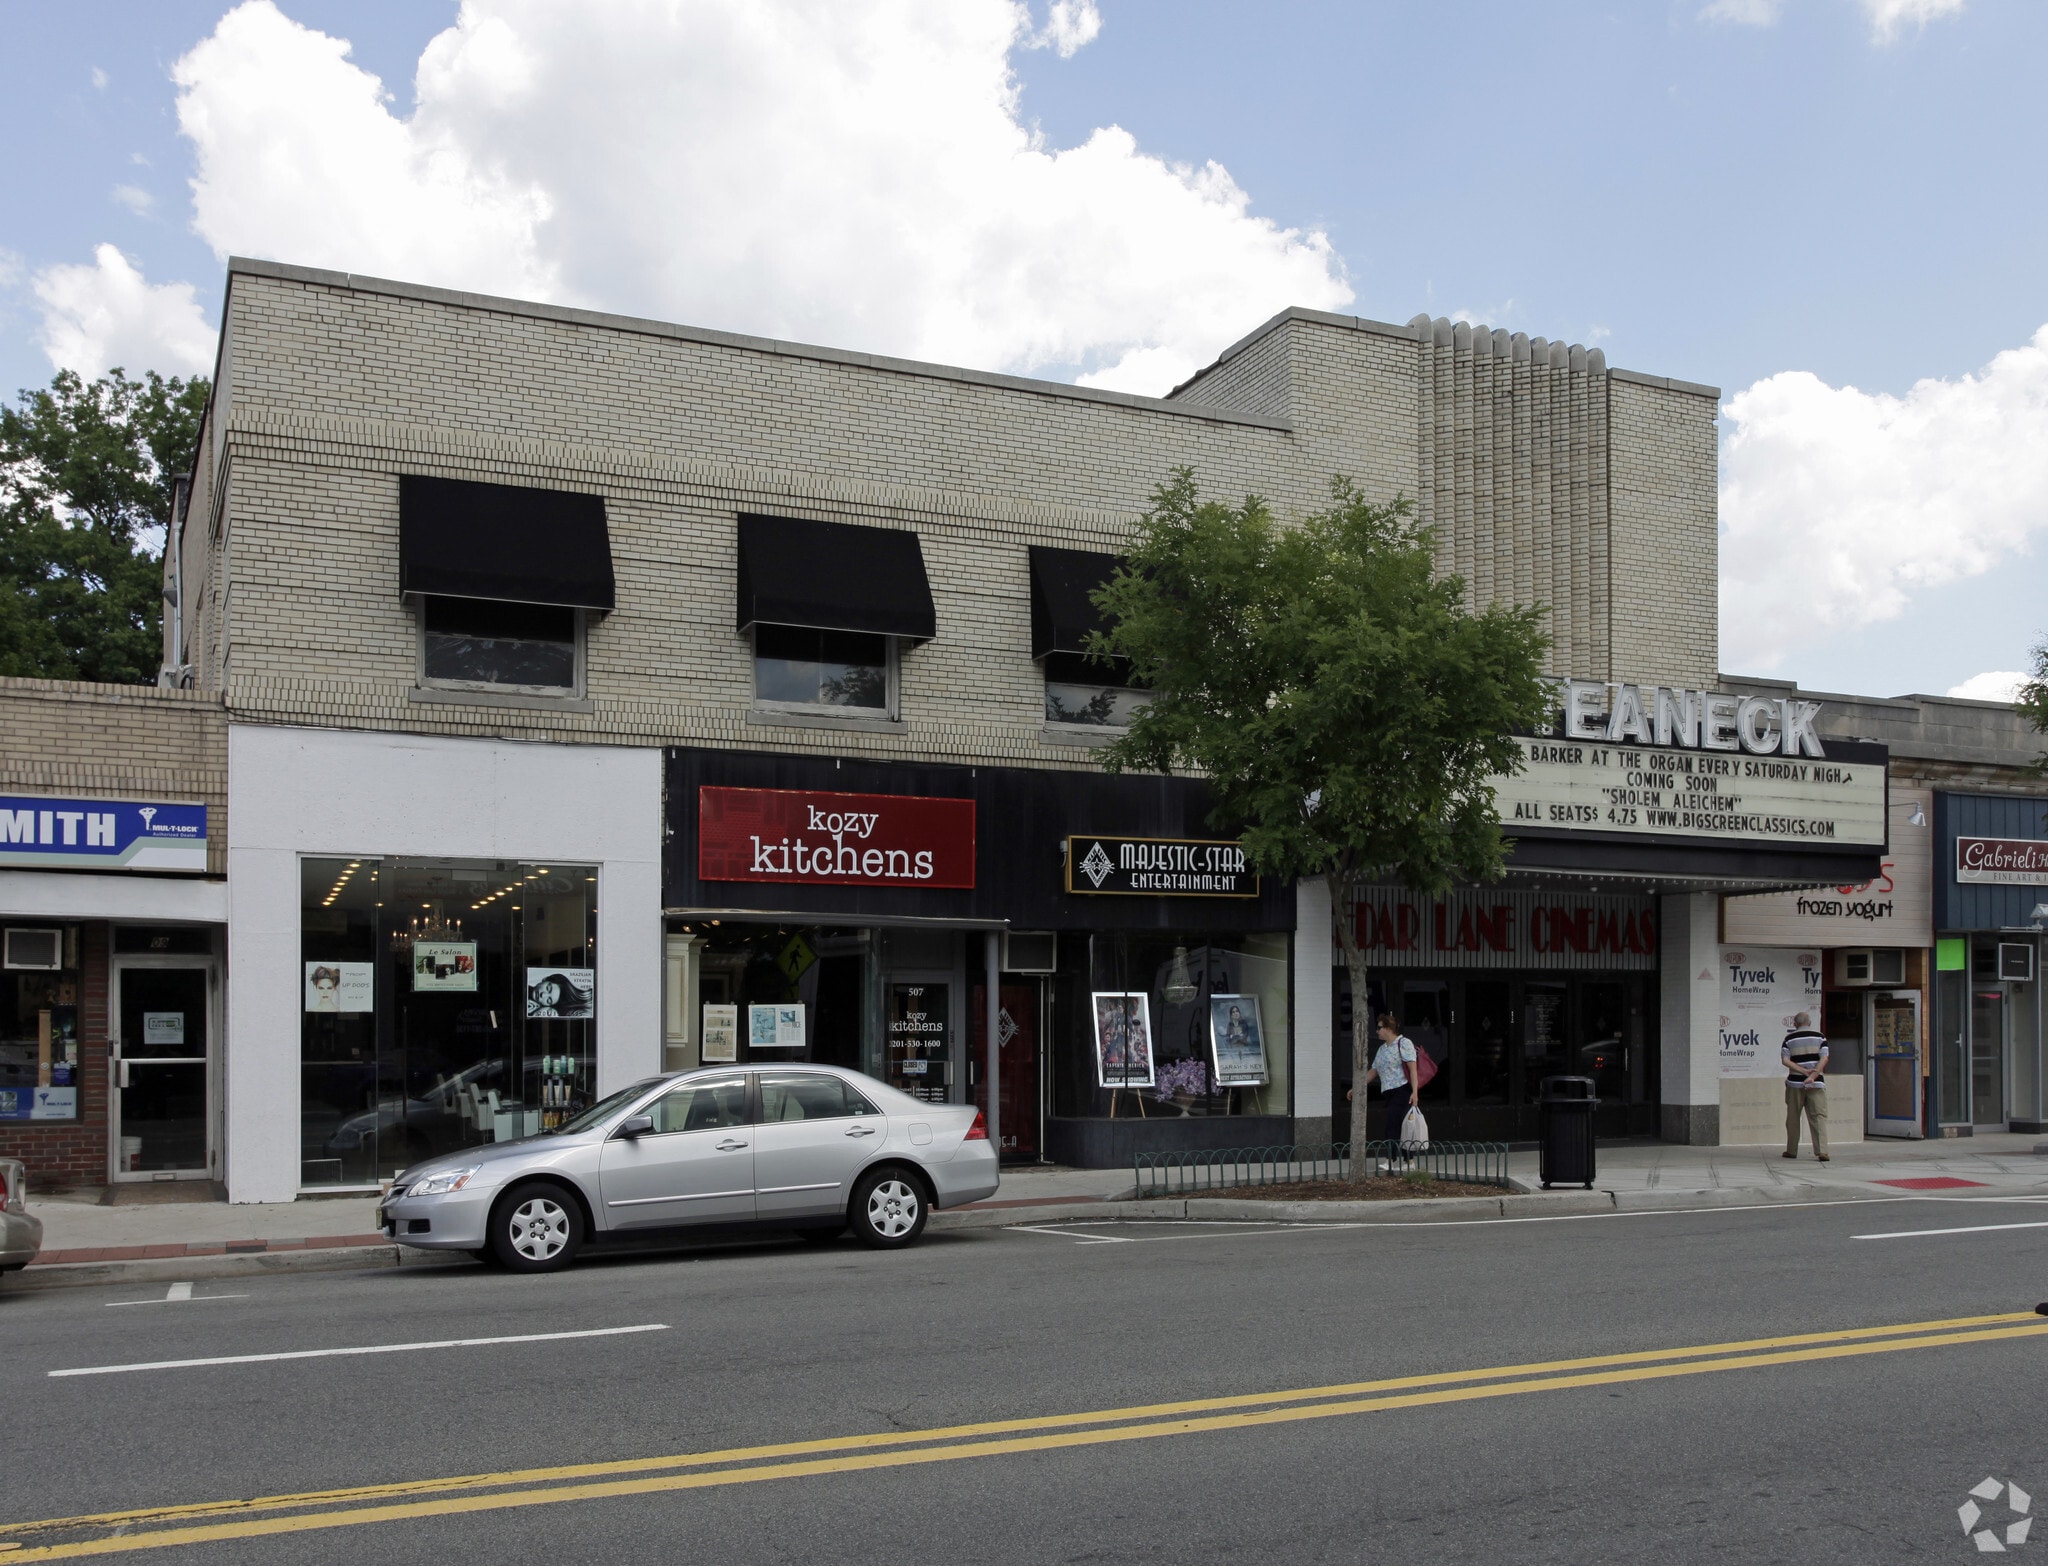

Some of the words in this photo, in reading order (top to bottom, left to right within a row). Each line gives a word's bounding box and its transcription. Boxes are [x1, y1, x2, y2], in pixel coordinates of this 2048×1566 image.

[1530, 745, 1583, 764] BARKER
[1591, 750, 1609, 766] AT
[1617, 751, 1641, 768] THE
[1649, 754, 1693, 773] ORGAN
[1744, 762, 1808, 781] SATURDAY
[1626, 771, 1674, 790] COMING
[1685, 775, 1718, 792] SOON
[1602, 788, 1661, 808] "SHOLEM
[1673, 791, 1742, 811] ALEICHEM"
[0, 808, 116, 847] MITH
[807, 804, 879, 838] kozy
[1514, 802, 1542, 820] ALL
[1646, 810, 1835, 836] WWW.BIGSCREENCLASSICS.COM
[750, 831, 934, 879] kitchens
[1120, 843, 1246, 873] MAJESTIC-STAR
[1962, 842, 2035, 878] Gabrieli
[1130, 873, 1236, 890] ENTERTAINMENT
[1993, 872, 2013, 881] FINE
[2017, 873, 2032, 881] ART
[1796, 896, 1843, 916] frozen
[1845, 899, 1893, 922] yogurt
[1435, 902, 1515, 952] LANE
[1531, 905, 1657, 955] CINEMAS
[1729, 965, 1775, 986] Tyvek
[908, 988, 924, 997] 507
[1732, 986, 1770, 995] HomeWrap
[892, 1019, 943, 1032] kitchens
[906, 1010, 927, 1021] kozy
[891, 1040, 941, 1048] 201-530-1600
